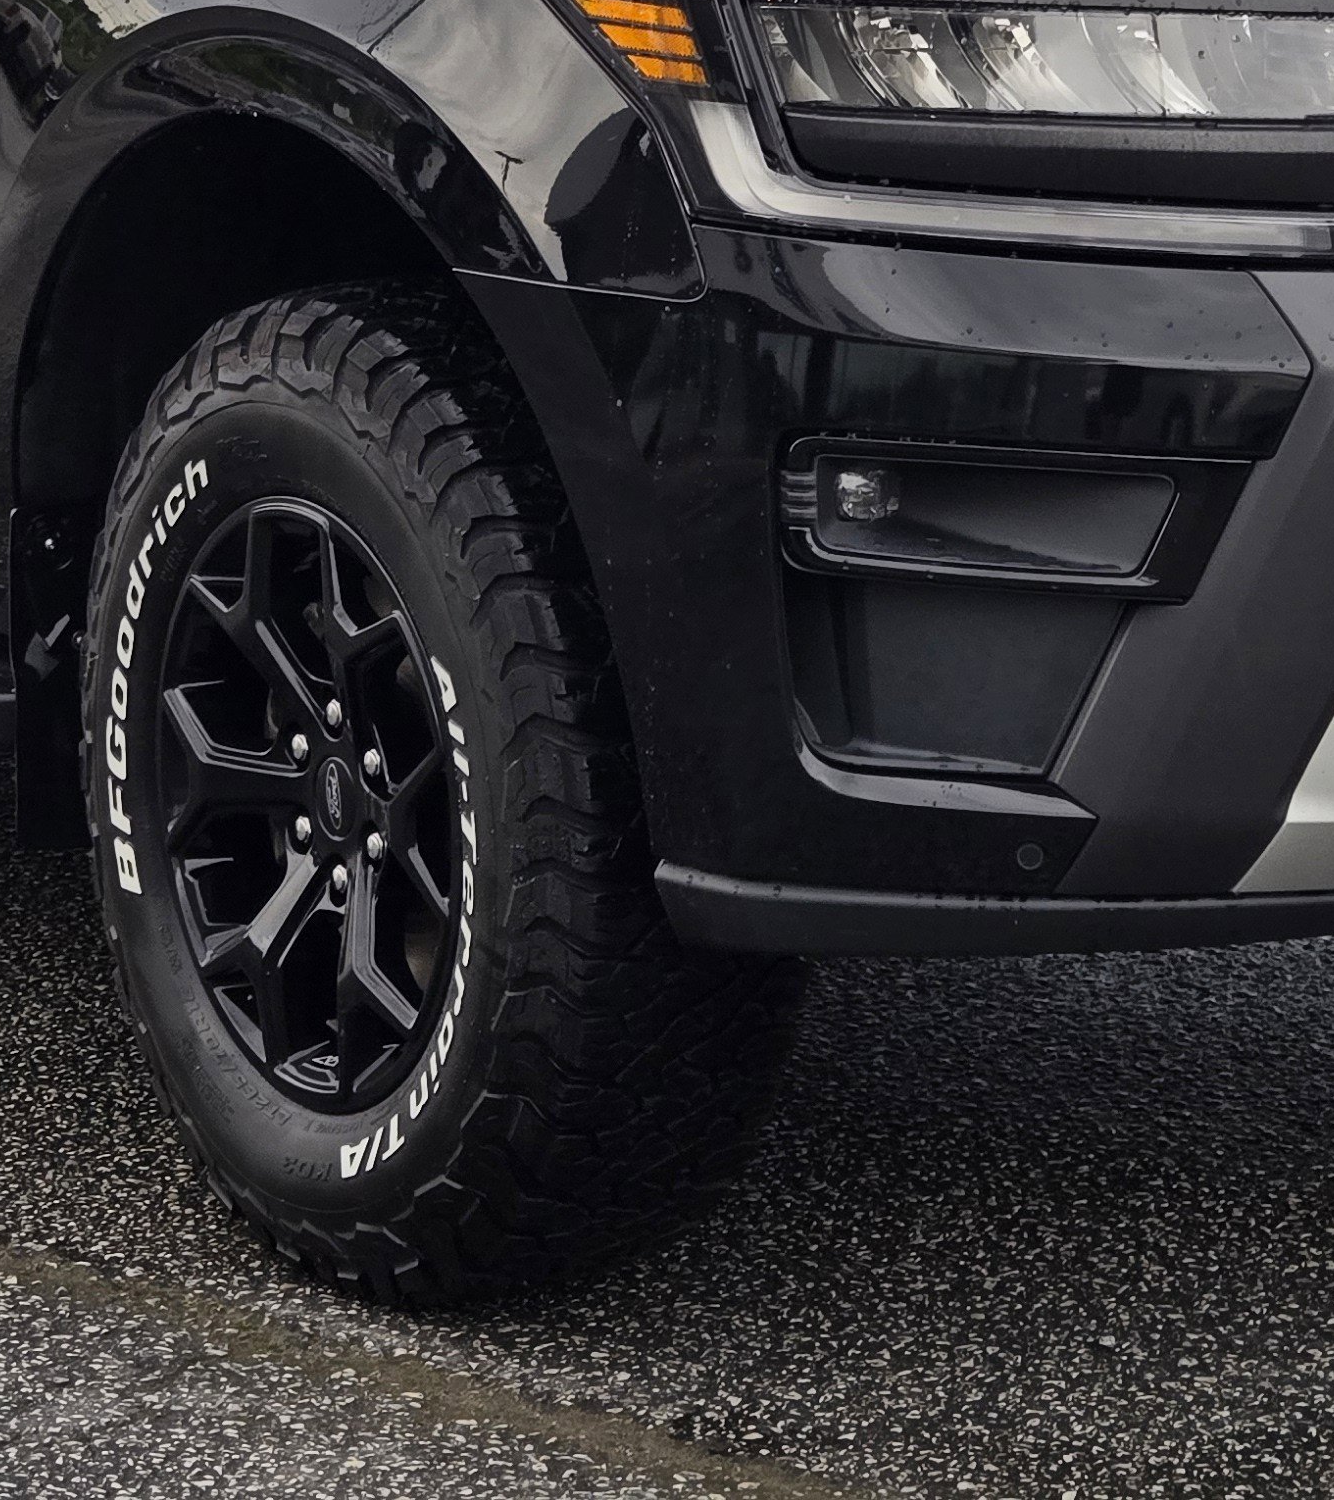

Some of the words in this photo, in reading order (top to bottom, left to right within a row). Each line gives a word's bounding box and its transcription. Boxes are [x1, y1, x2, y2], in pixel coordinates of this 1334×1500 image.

[104, 458, 210, 896] BFGoodrich
[406, 654, 478, 1120] All-Terrain
[339, 1112, 406, 1180] T/A
